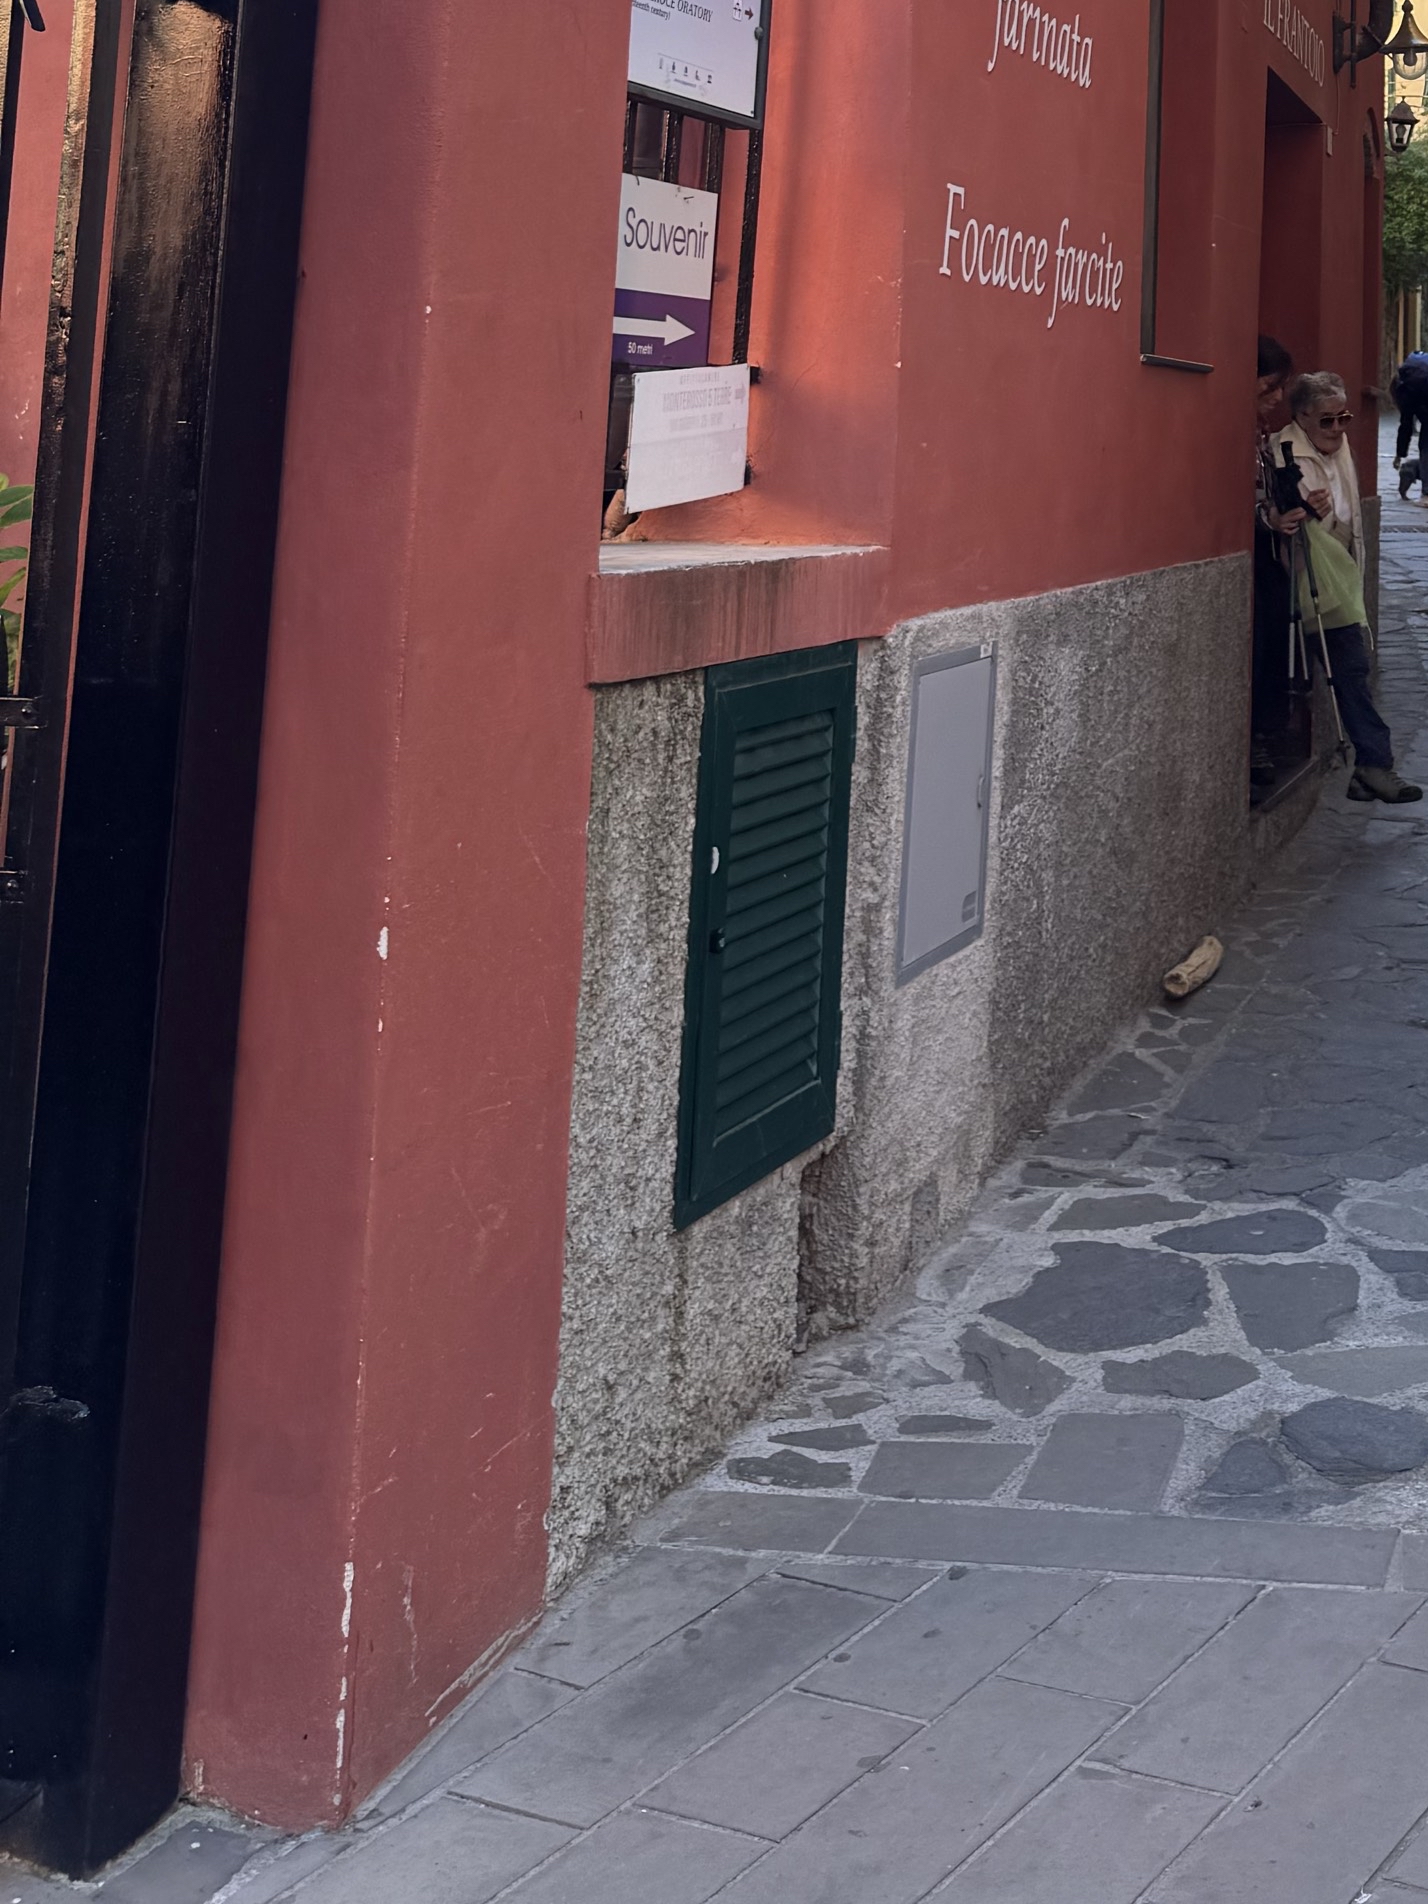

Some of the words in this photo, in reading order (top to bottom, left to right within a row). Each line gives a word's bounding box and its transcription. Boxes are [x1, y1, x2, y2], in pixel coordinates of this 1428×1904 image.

[677, 0, 713, 23] ORATORY
[624, 206, 709, 259] Souvenir
[939, 183, 1048, 297] Focacce
[1047, 218, 1123, 328] farcite
[627, 342, 636, 354] 50
[637, 344, 653, 355] metri
